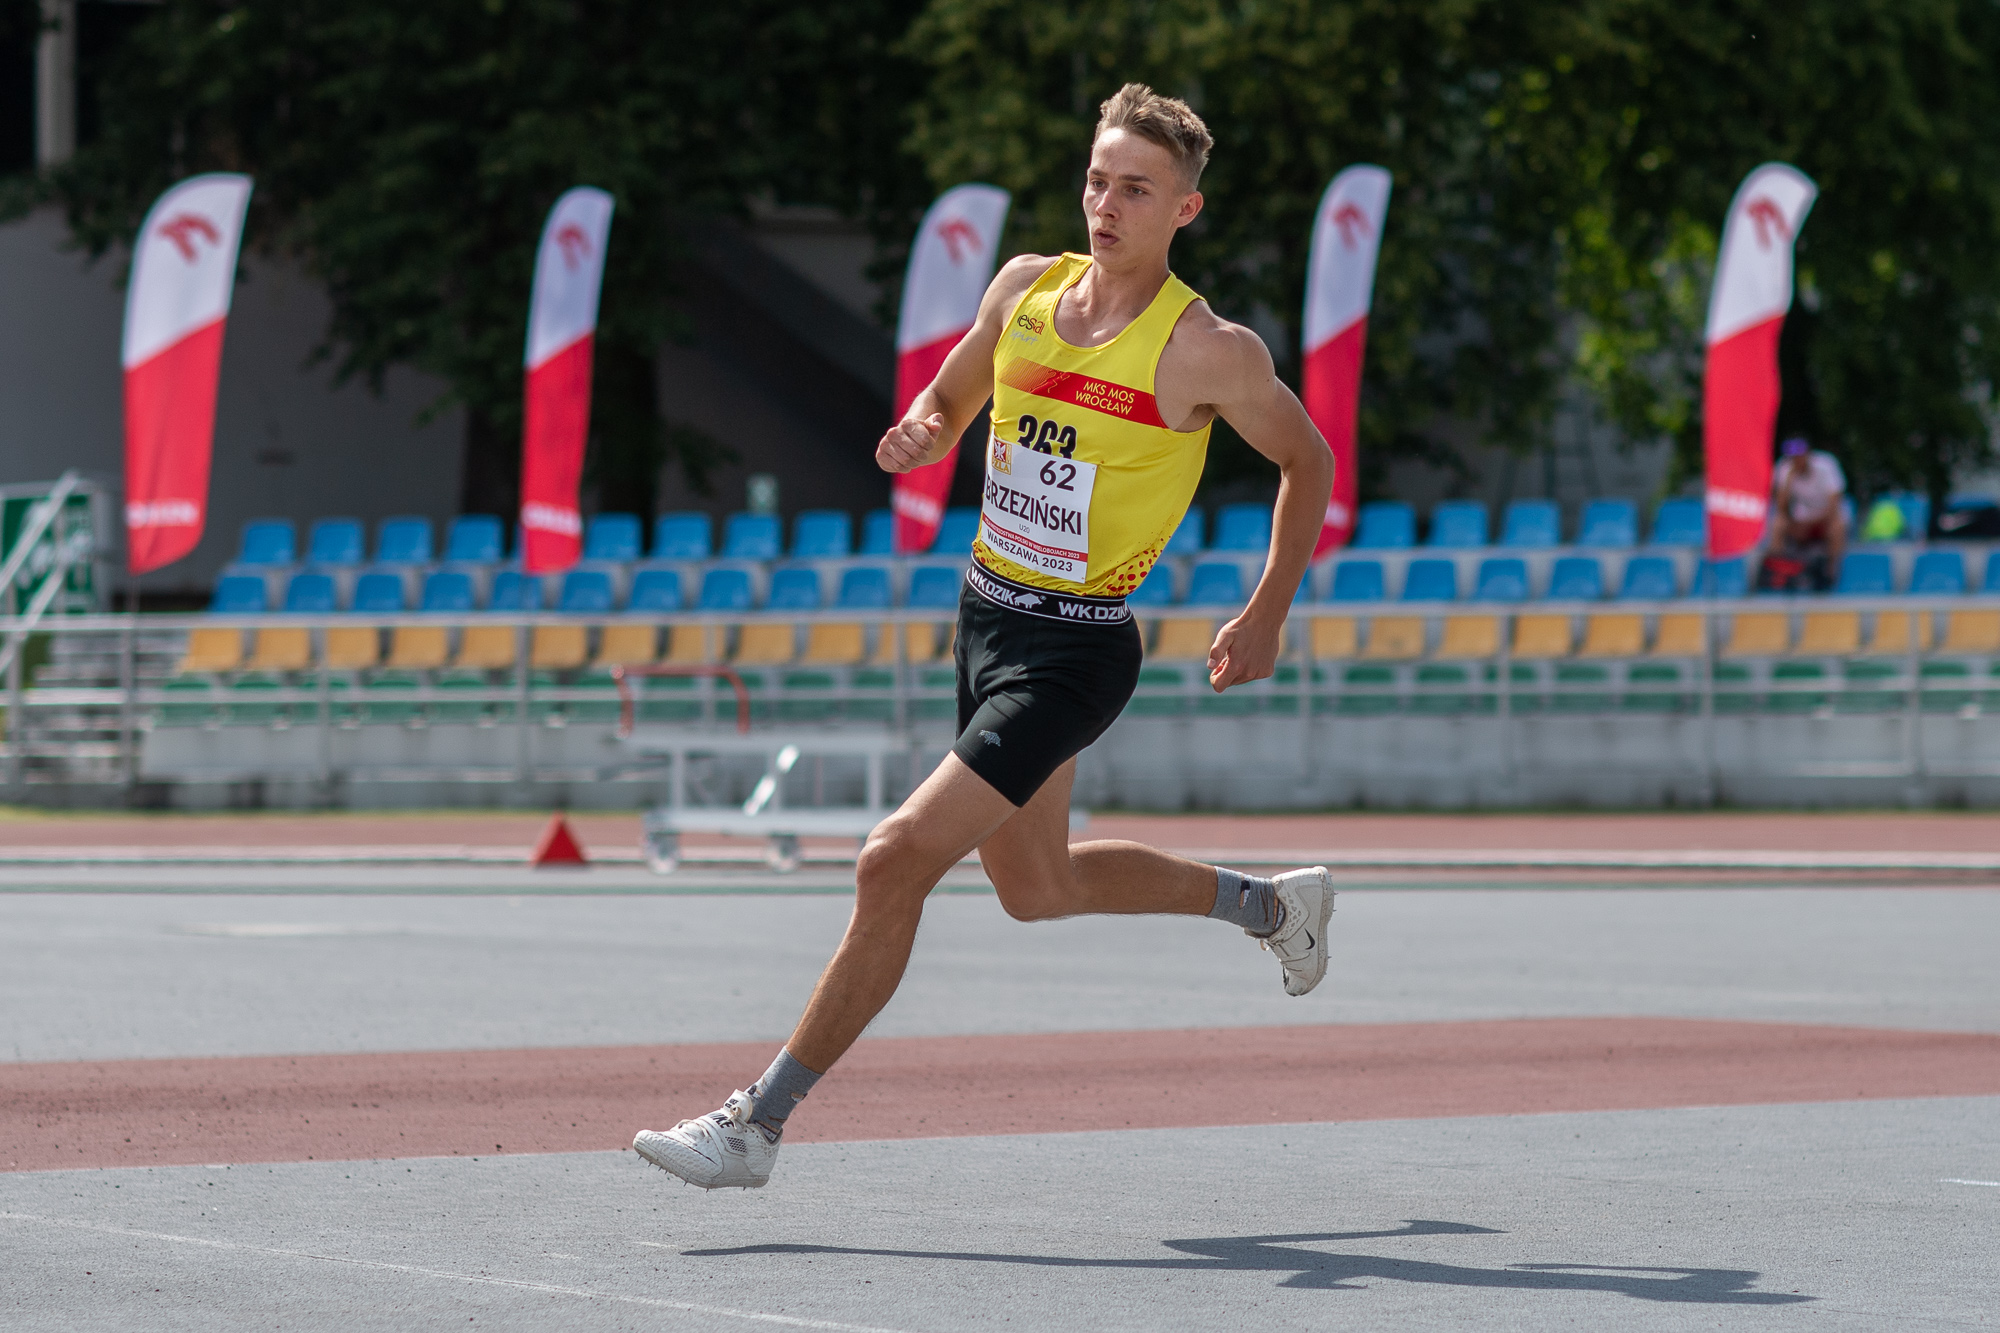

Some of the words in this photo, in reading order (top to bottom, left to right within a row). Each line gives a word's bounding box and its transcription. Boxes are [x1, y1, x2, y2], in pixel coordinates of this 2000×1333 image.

[1076, 390, 1132, 415] WROCŁAW
[1083, 381, 1106, 395] MKS
[1107, 387, 1135, 403] MOS
[1017, 414, 1077, 459] 363
[991, 459, 1009, 472] ZLA
[1040, 460, 1076, 491] 62
[1018, 523, 1031, 534] U20
[986, 529, 1039, 566] WARSZAWA
[1041, 557, 1073, 572] 2023
[1067, 551, 1080, 559] 2023
